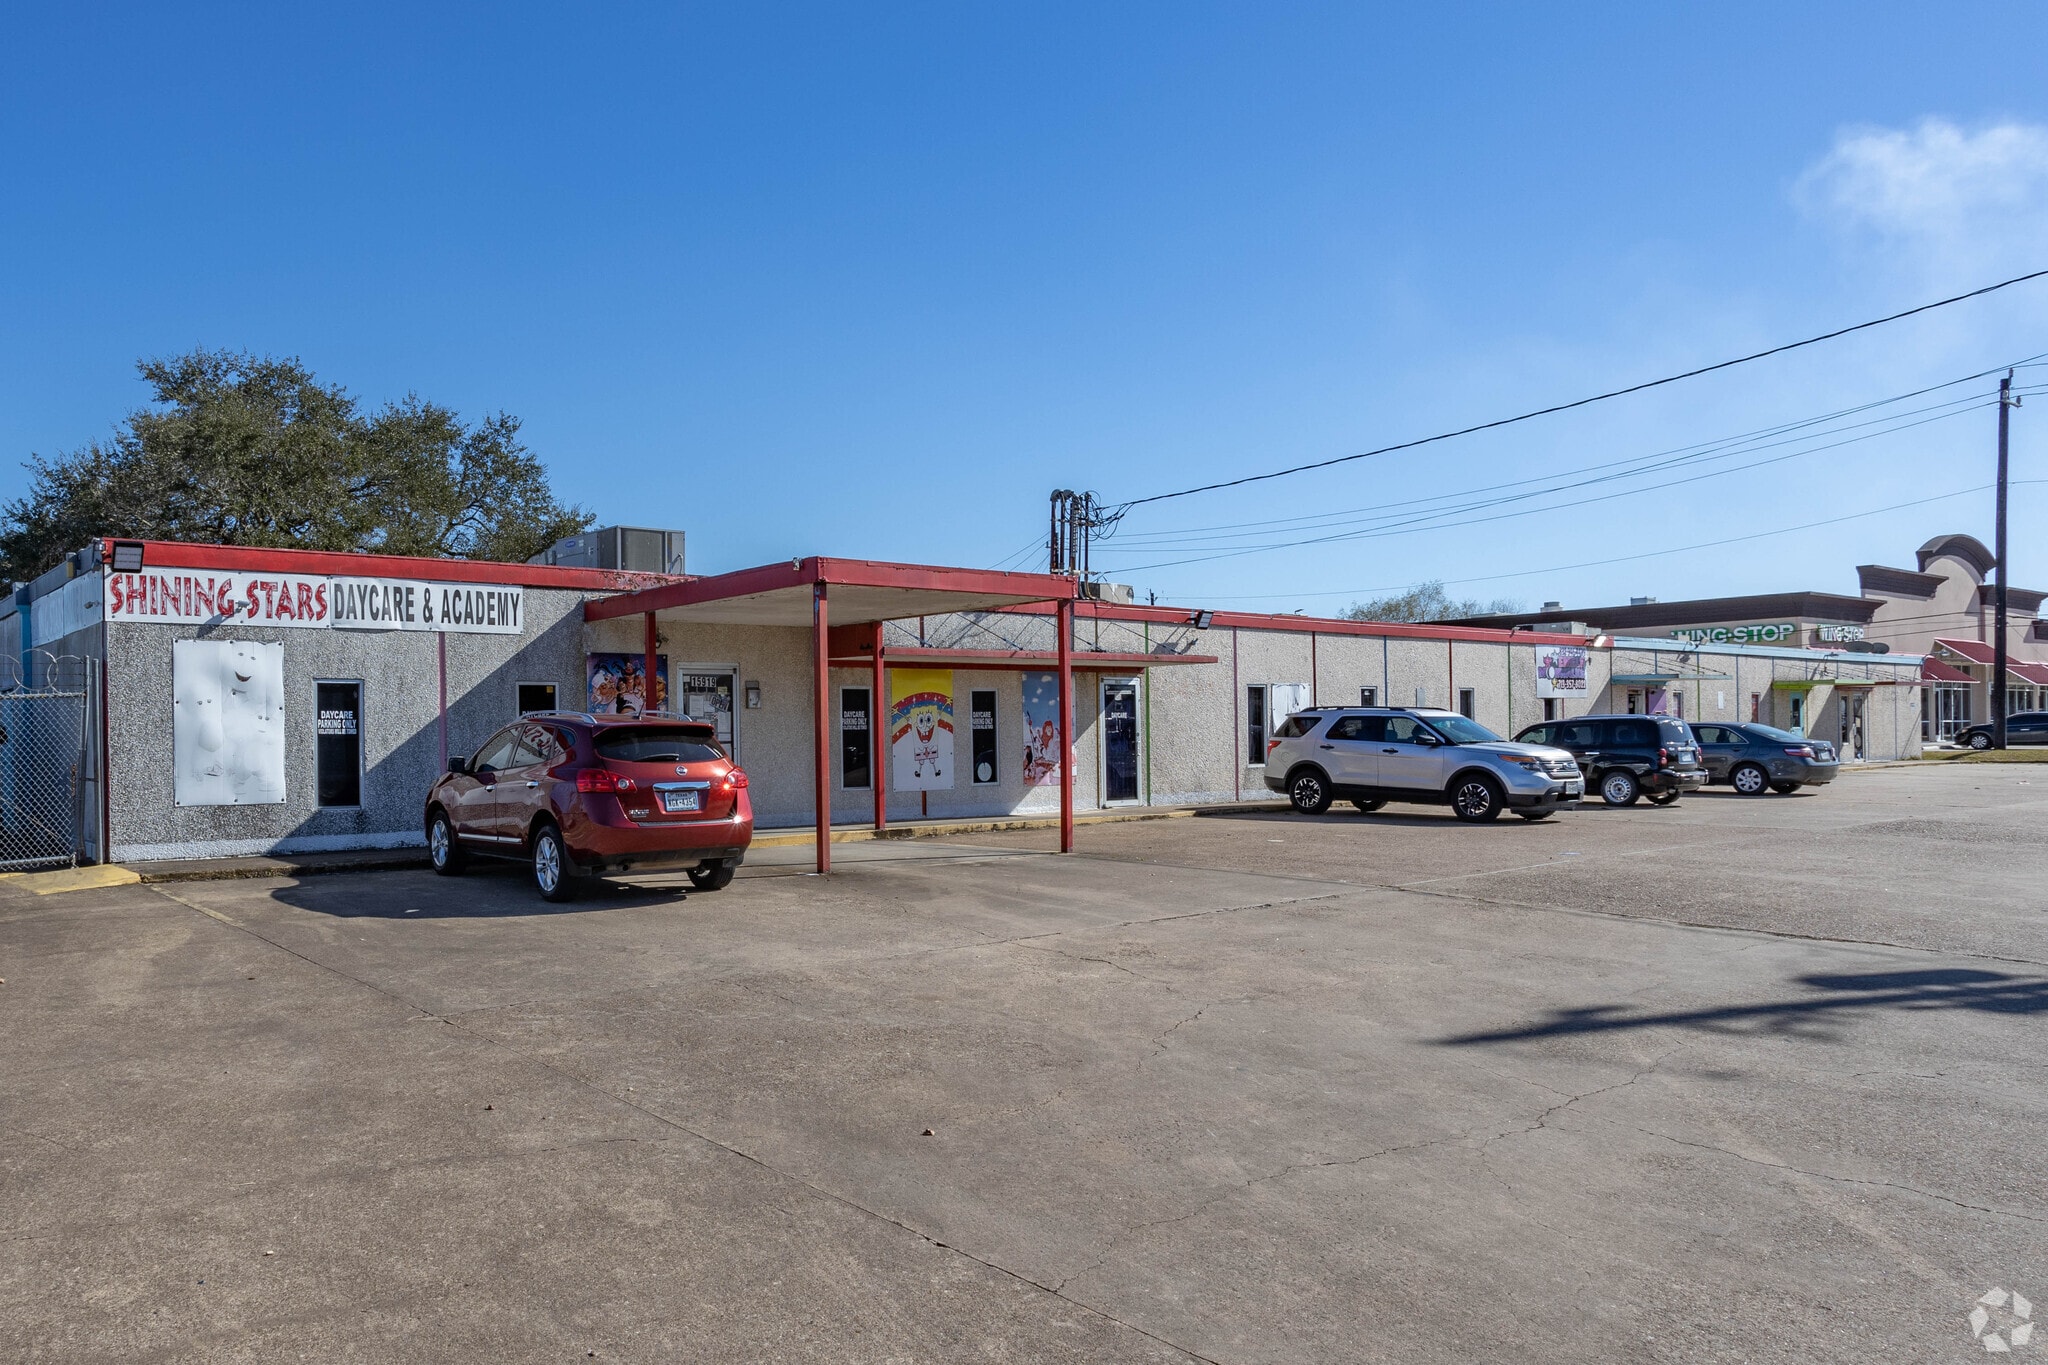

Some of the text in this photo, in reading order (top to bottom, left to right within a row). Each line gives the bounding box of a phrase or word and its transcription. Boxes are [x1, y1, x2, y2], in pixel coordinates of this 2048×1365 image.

[110, 573, 327, 622] SHINING STARS
[333, 583, 520, 627] DAYCARE & ACADEMY
[691, 677, 716, 687] 15919
[321, 711, 353, 719] DAYCARE
[843, 710, 865, 718] DAYCARE
[318, 720, 357, 728] PARKING ONLY
